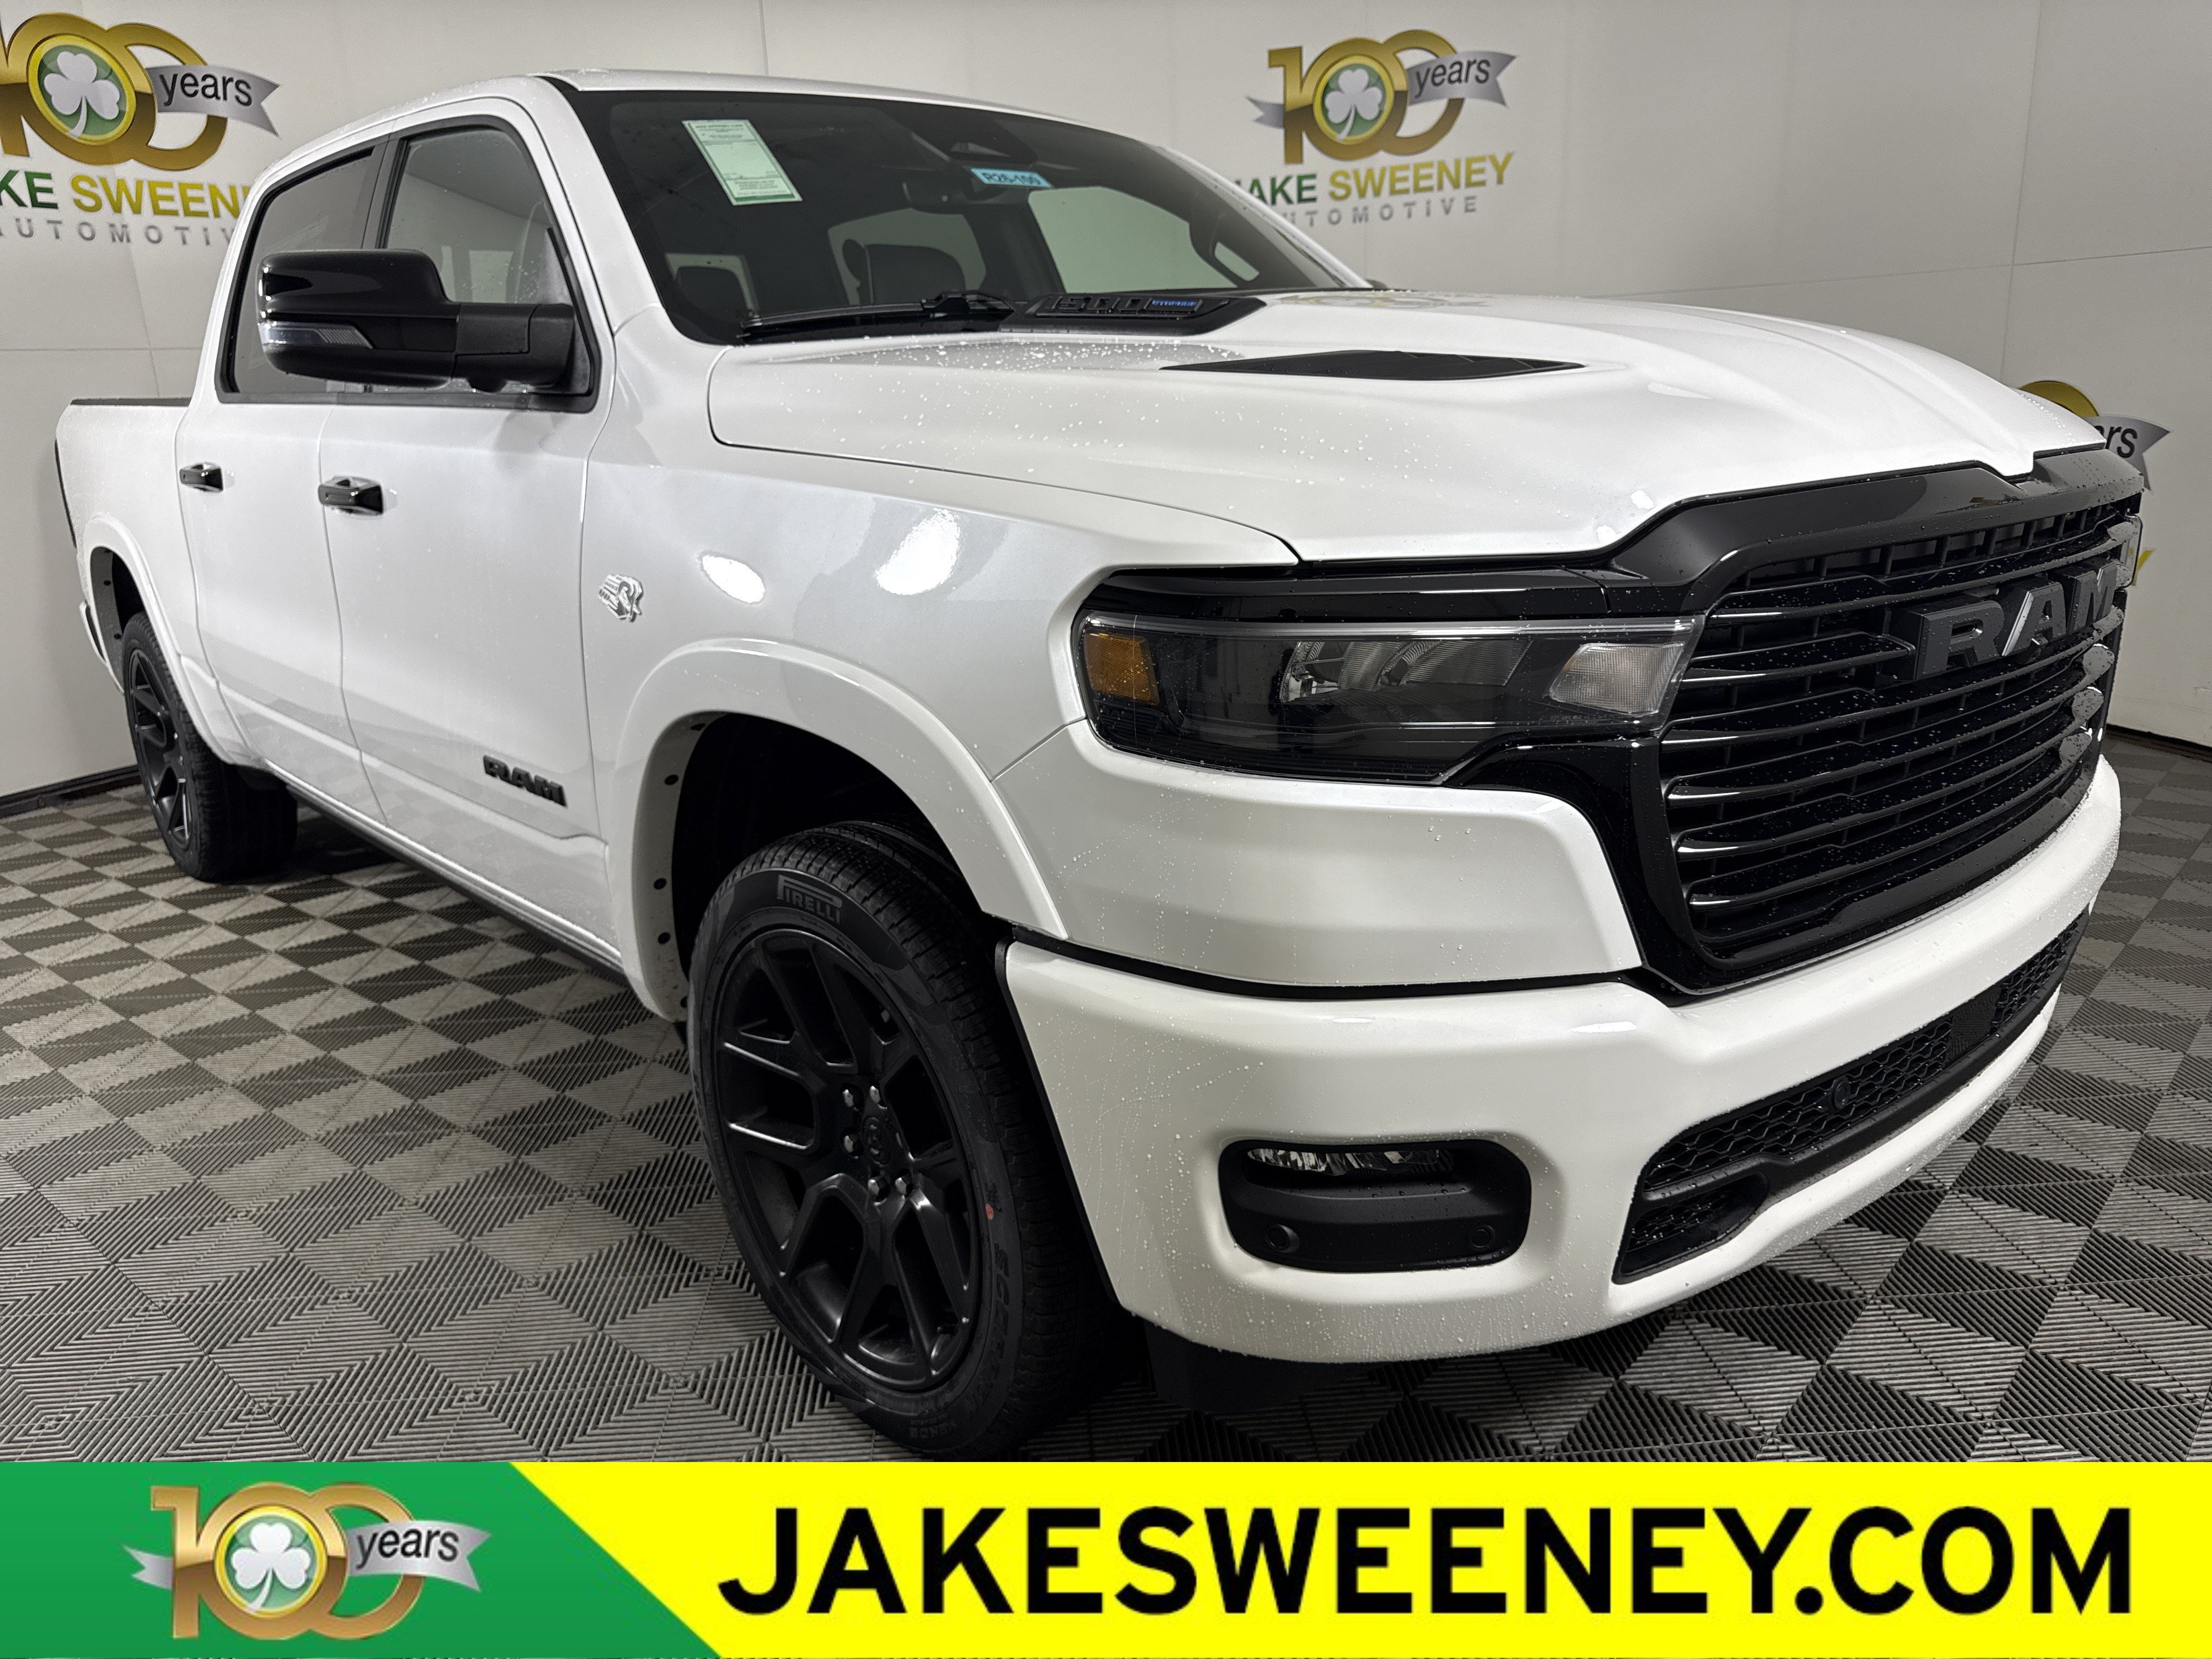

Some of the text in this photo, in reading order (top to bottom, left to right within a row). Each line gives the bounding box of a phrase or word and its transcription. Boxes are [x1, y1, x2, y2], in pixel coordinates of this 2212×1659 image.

[159, 72, 253, 106] years
[1414, 57, 1492, 98] years
[0, 170, 252, 218] KE SWEEN
[1235, 153, 1513, 206] AKE SWEENEY
[1914, 560, 2119, 681] RAM
[483, 755, 568, 807] RAM
[776, 874, 843, 925] PIRELLI
